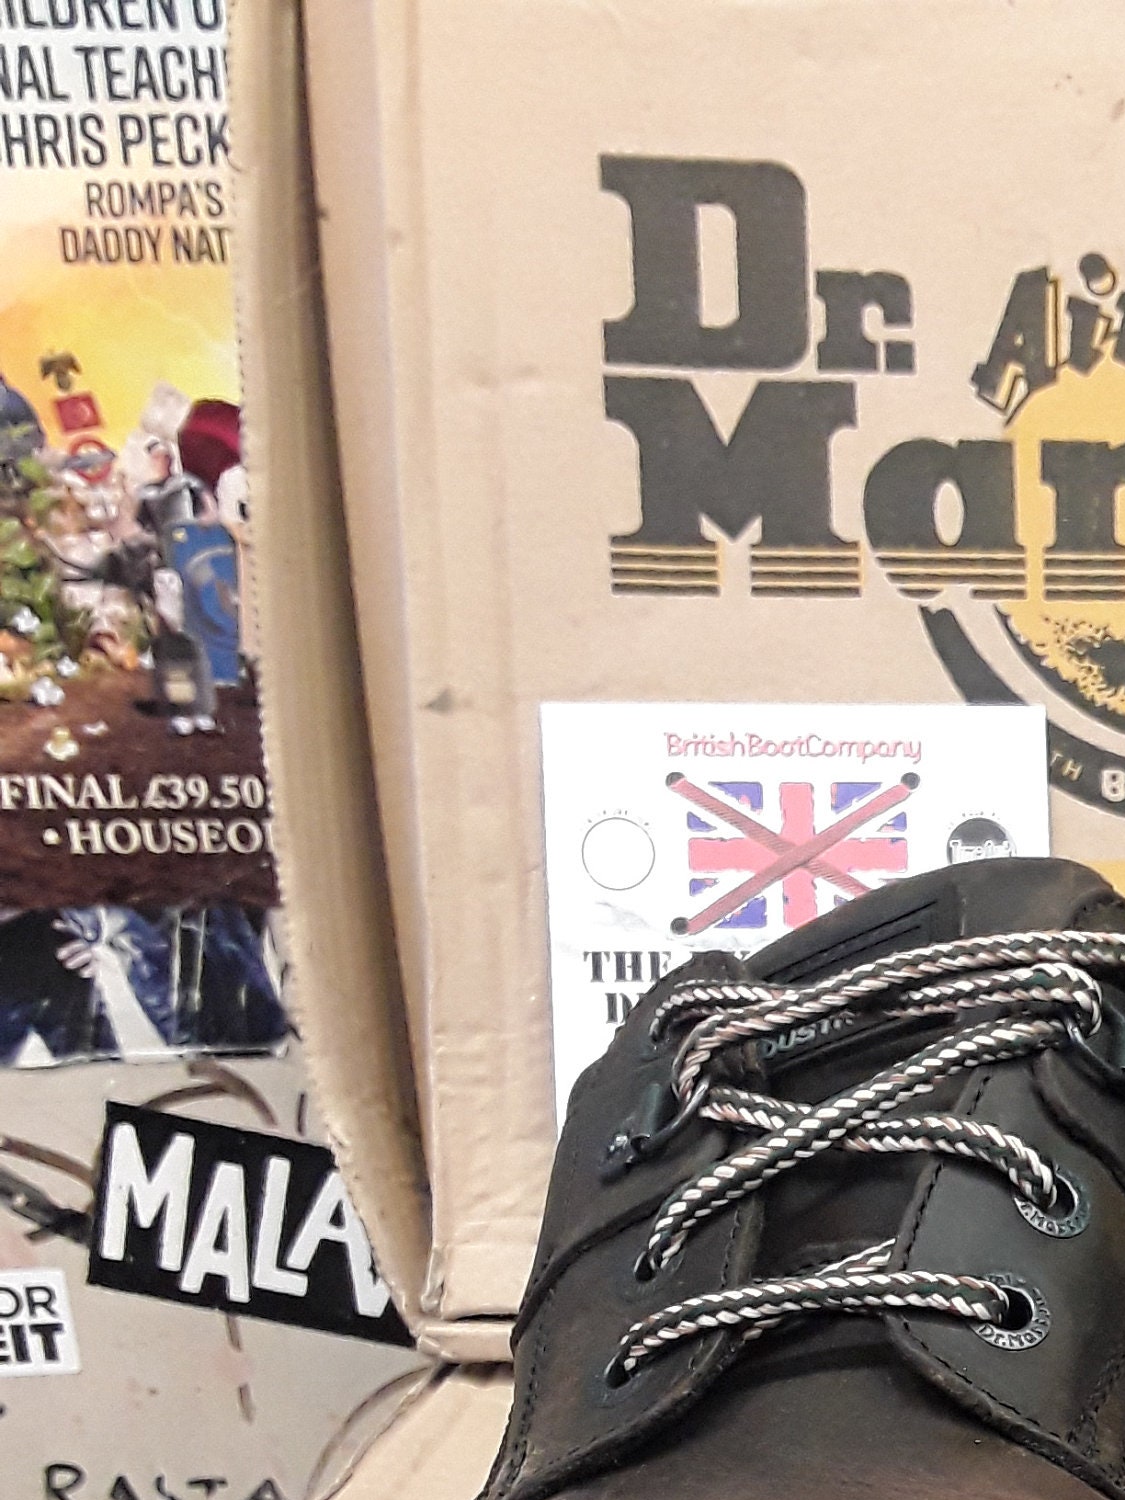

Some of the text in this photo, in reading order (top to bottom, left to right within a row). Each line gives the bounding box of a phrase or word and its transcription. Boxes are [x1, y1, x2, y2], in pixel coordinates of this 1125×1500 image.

[73, 46, 228, 100] TEACH
[86, 181, 224, 218] ROMPA'S
[61, 226, 163, 264] DADDY
[598, 152, 917, 375] Dr.
[0, 773, 265, 810] FINAL £39.50
